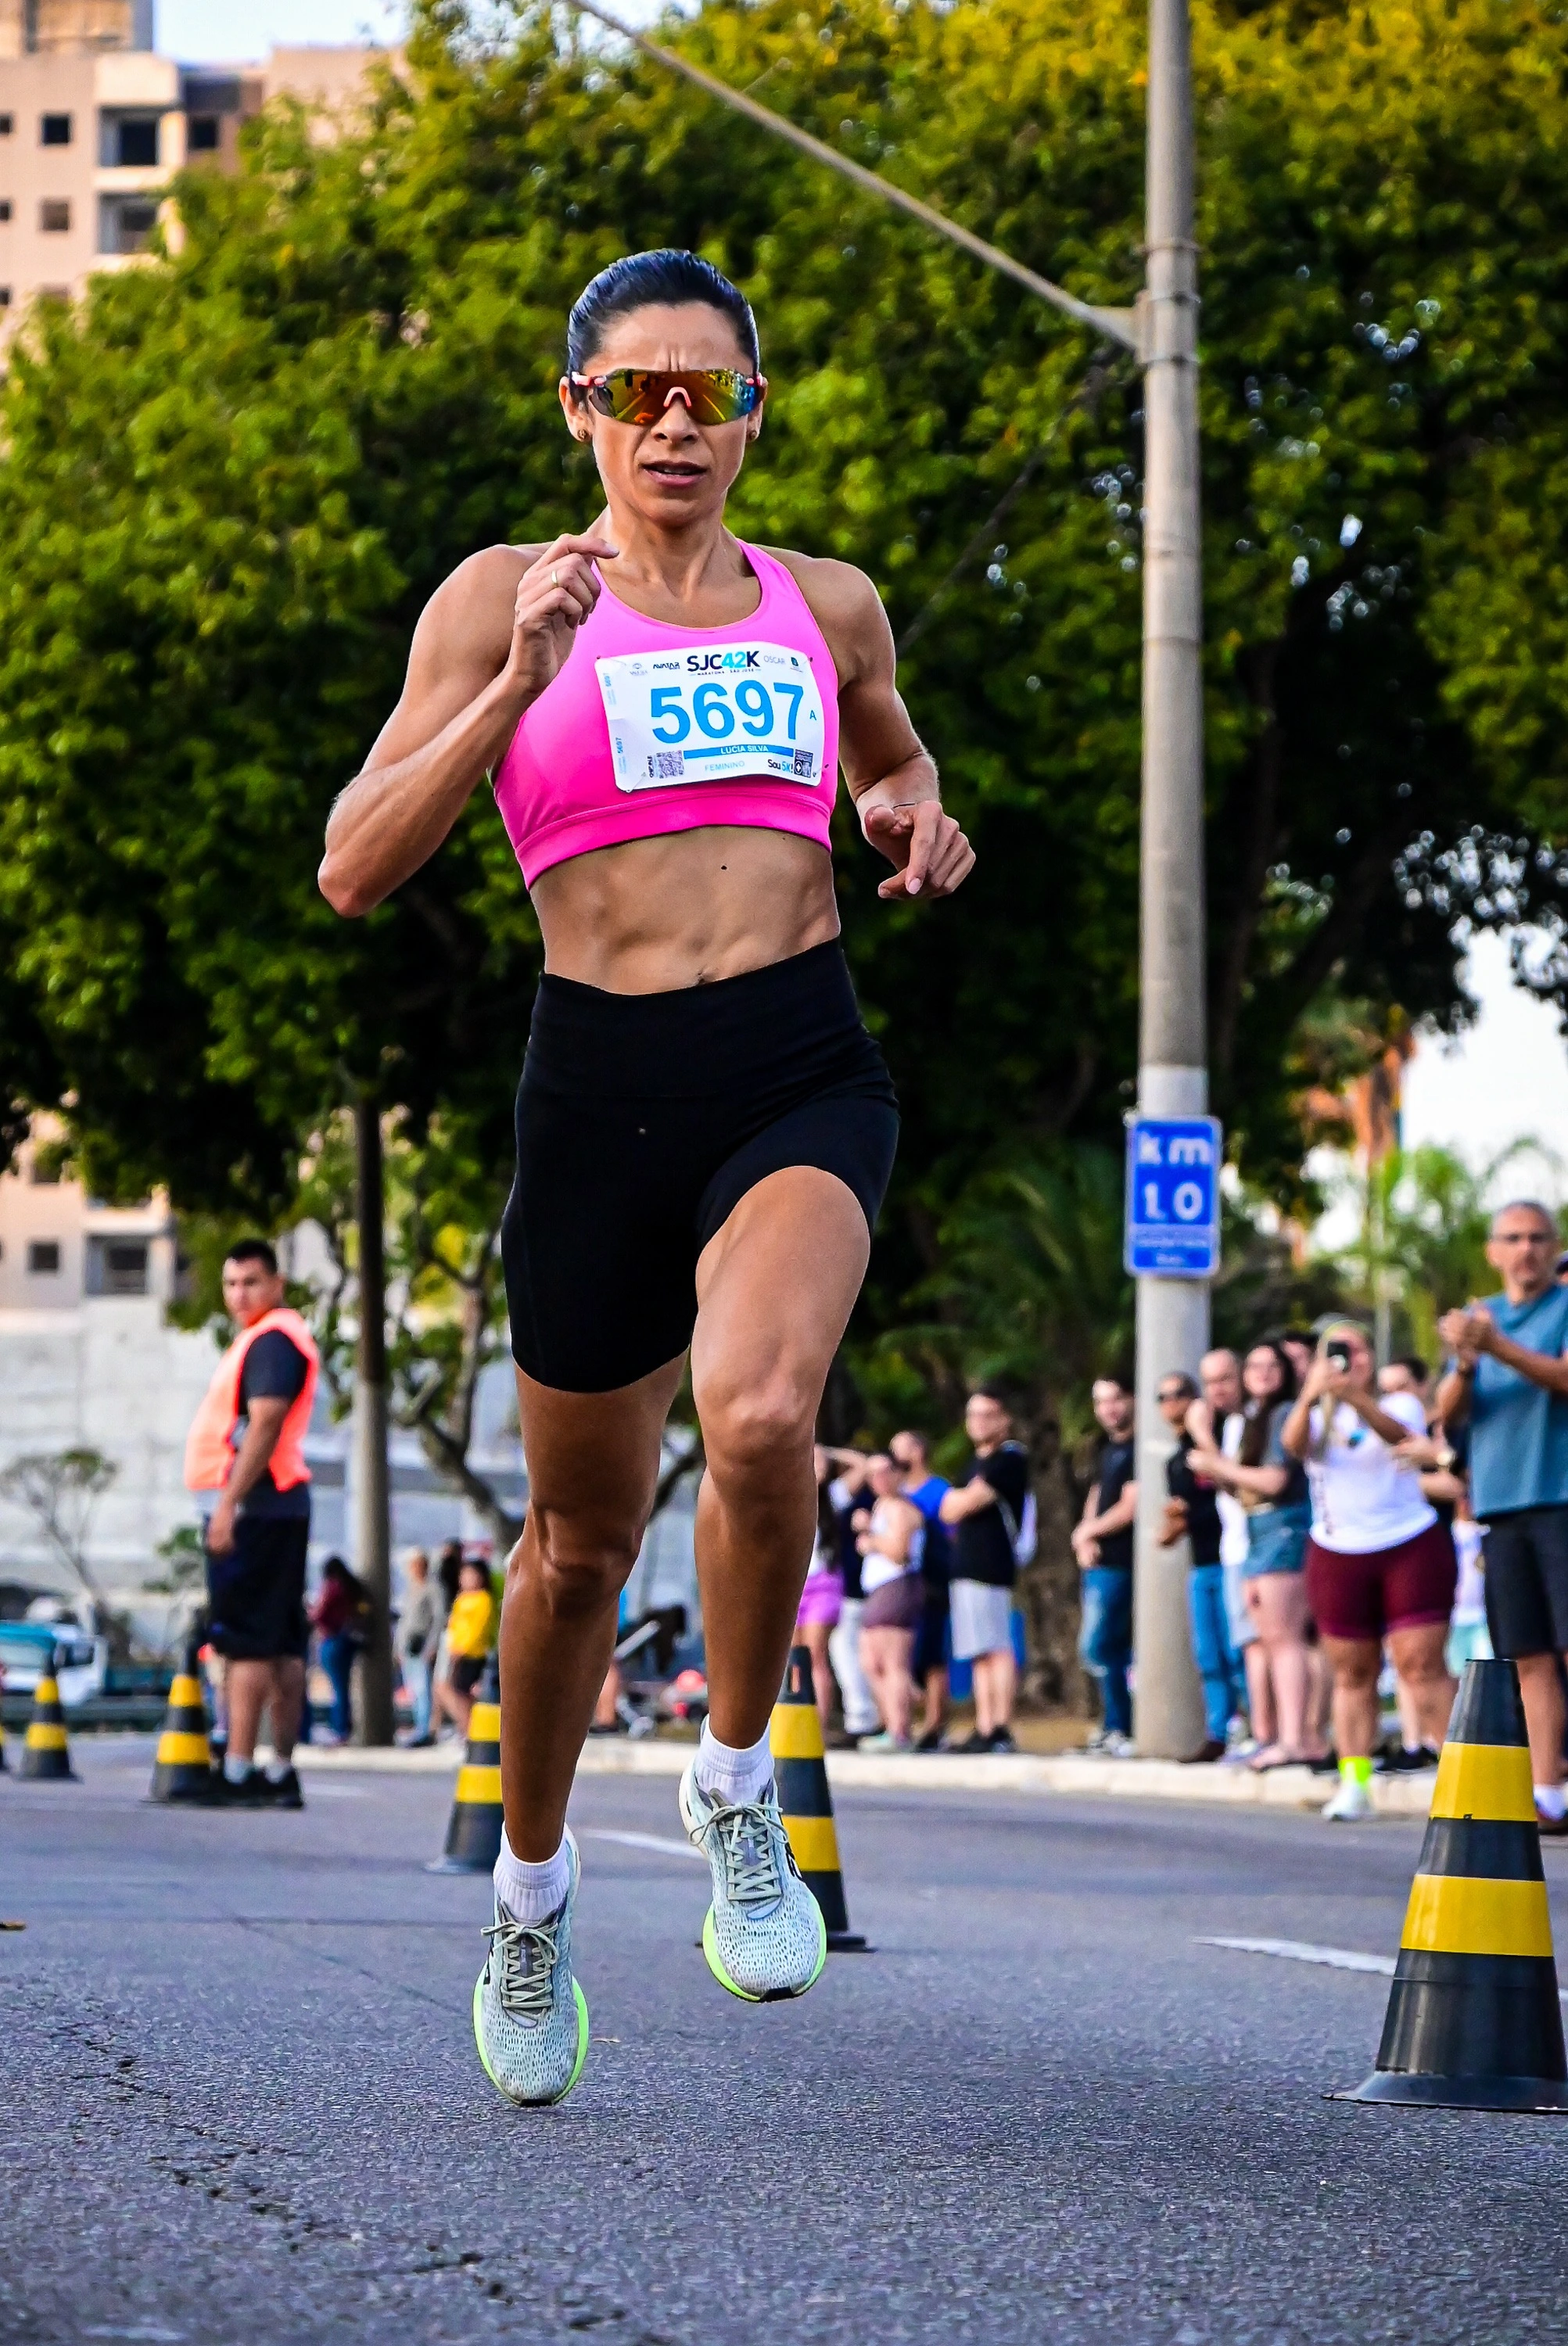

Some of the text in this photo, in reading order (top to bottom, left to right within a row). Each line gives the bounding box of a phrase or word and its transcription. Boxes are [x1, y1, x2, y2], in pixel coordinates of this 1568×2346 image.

[687, 651, 760, 672] SJC42K
[763, 655, 786, 665] OSCAR
[652, 662, 680, 670] AVATAR
[651, 680, 804, 744] 5697
[809, 710, 817, 721] A
[615, 737, 624, 754] 5697
[720, 745, 746, 755] LUCIA
[705, 760, 745, 772] FEMININO
[767, 759, 781, 770] Sou
[1138, 1131, 1211, 1165] km
